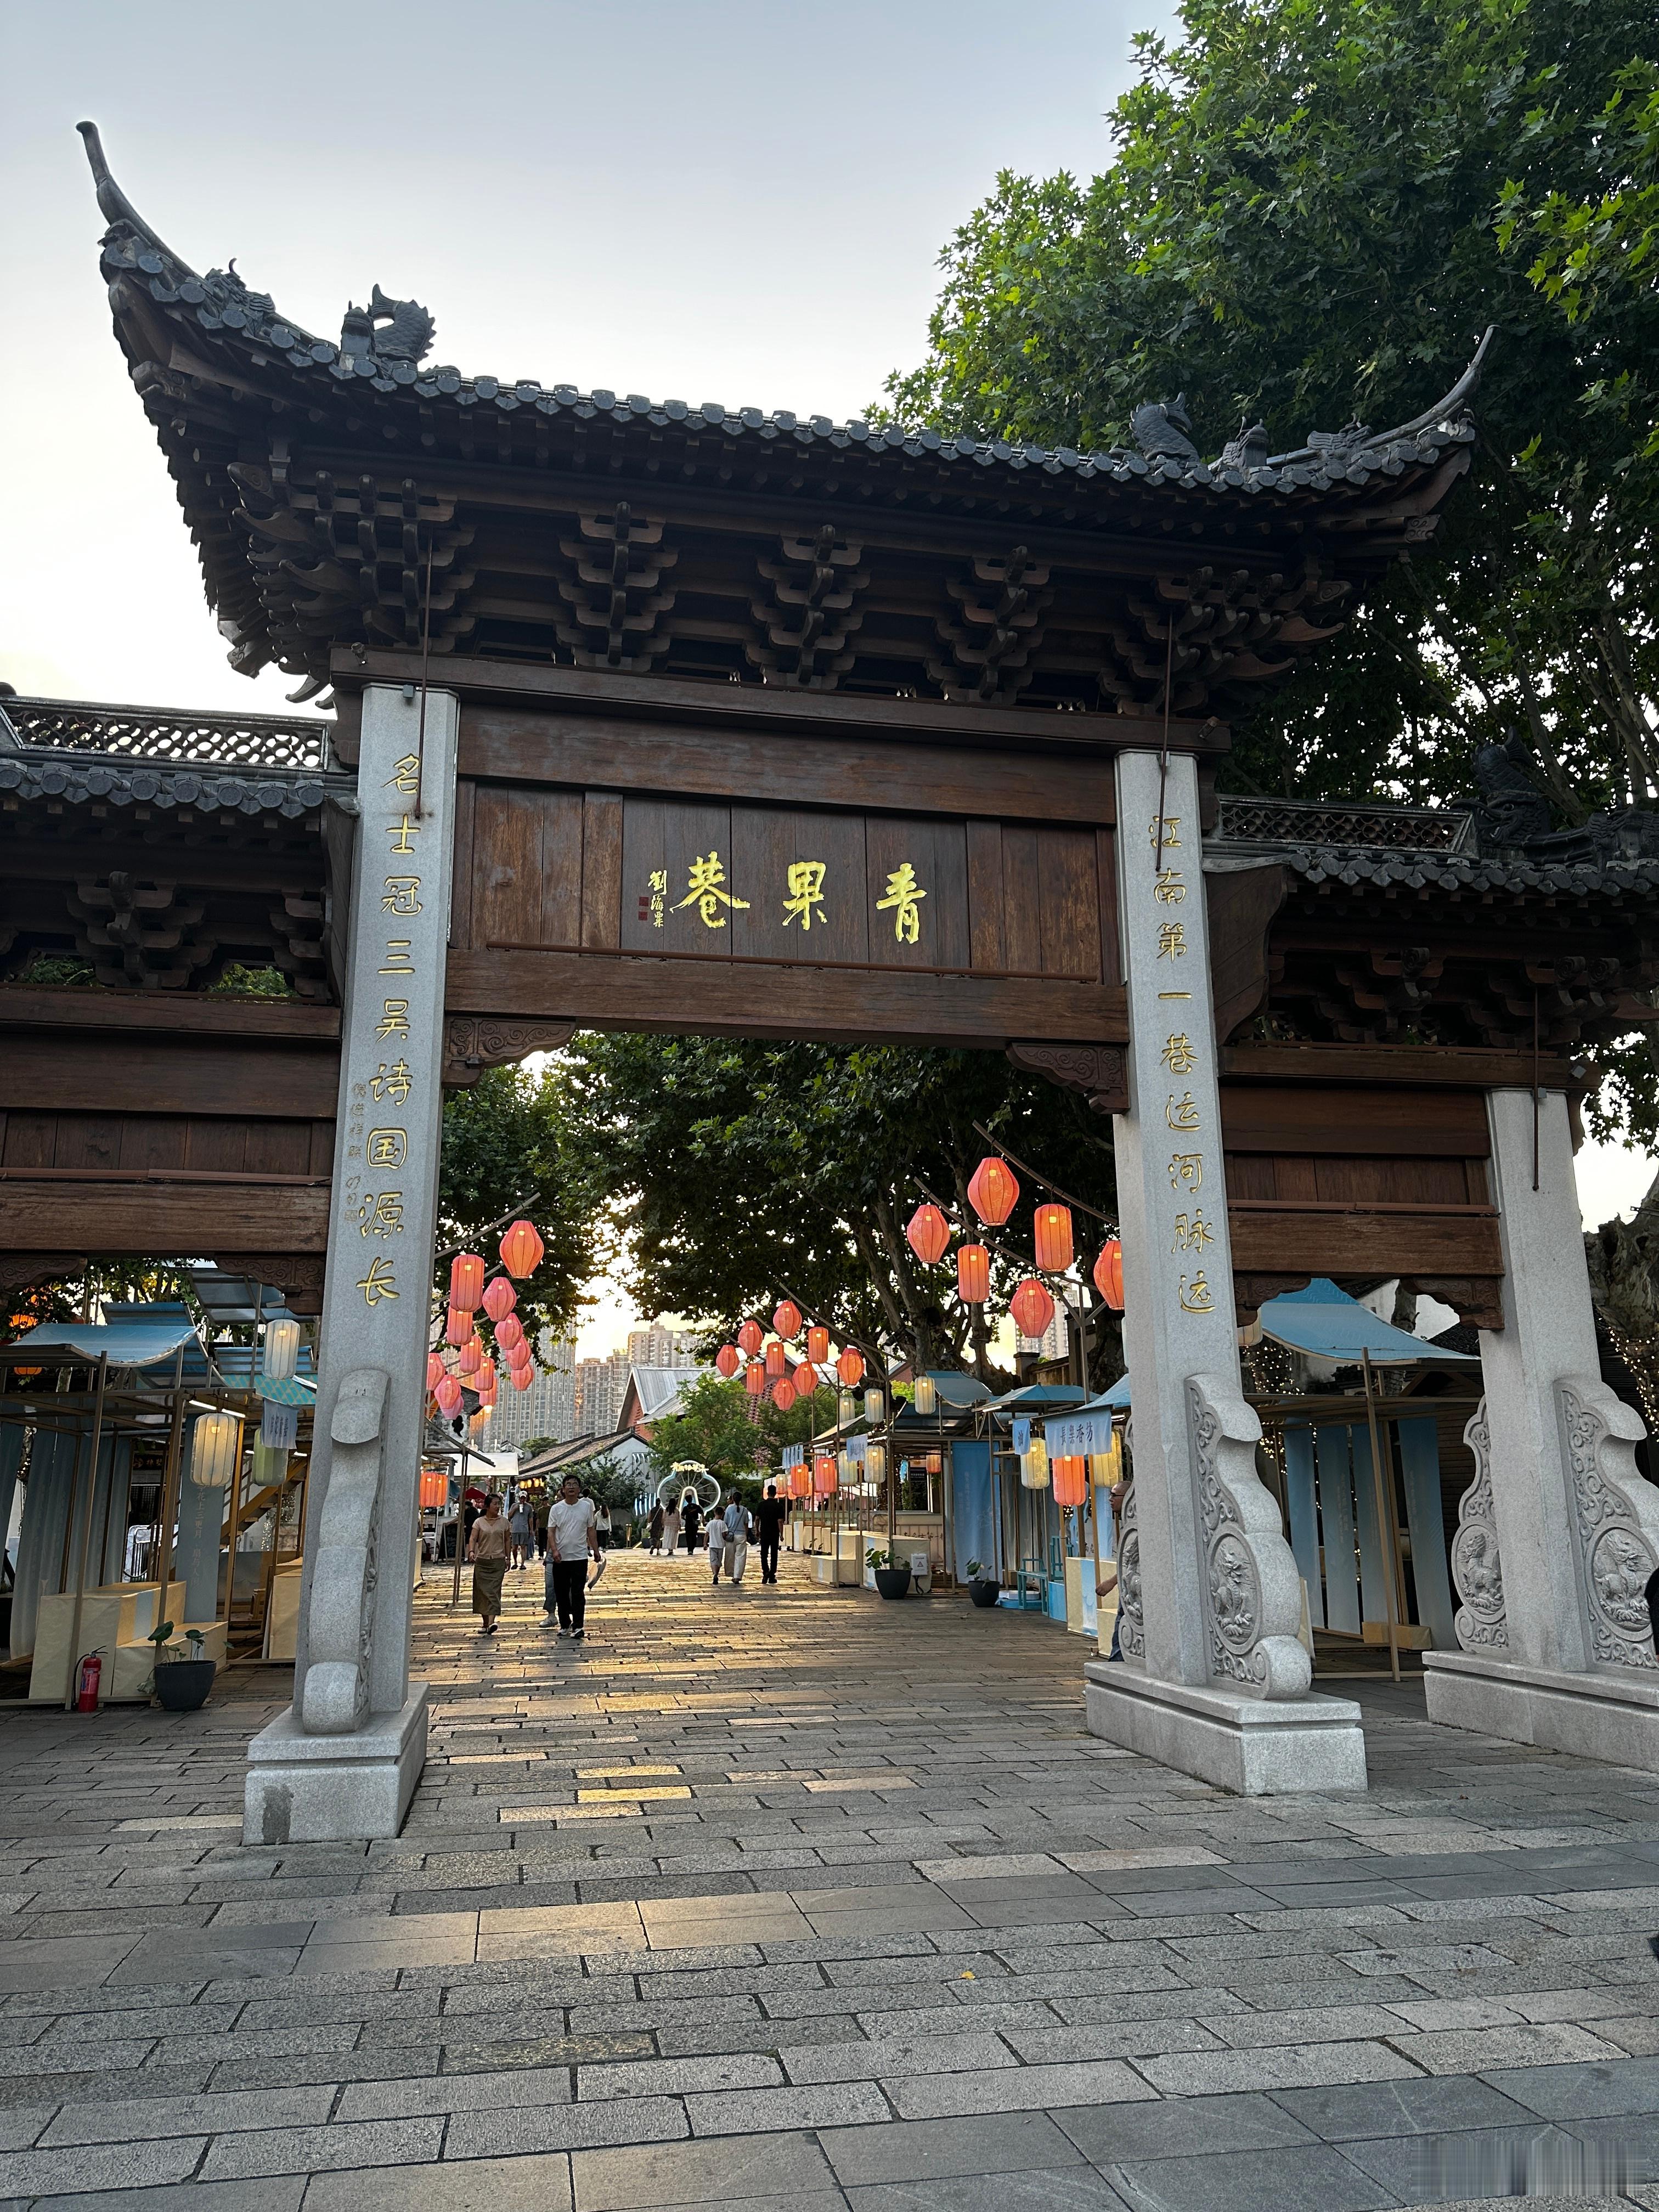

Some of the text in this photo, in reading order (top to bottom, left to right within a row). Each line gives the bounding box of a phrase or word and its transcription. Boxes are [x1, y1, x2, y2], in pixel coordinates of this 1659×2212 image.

[355, 753, 422, 1307] 名士冠三吴诗国源长
[1148, 815, 1216, 1314] 江南第一巷运河脉远
